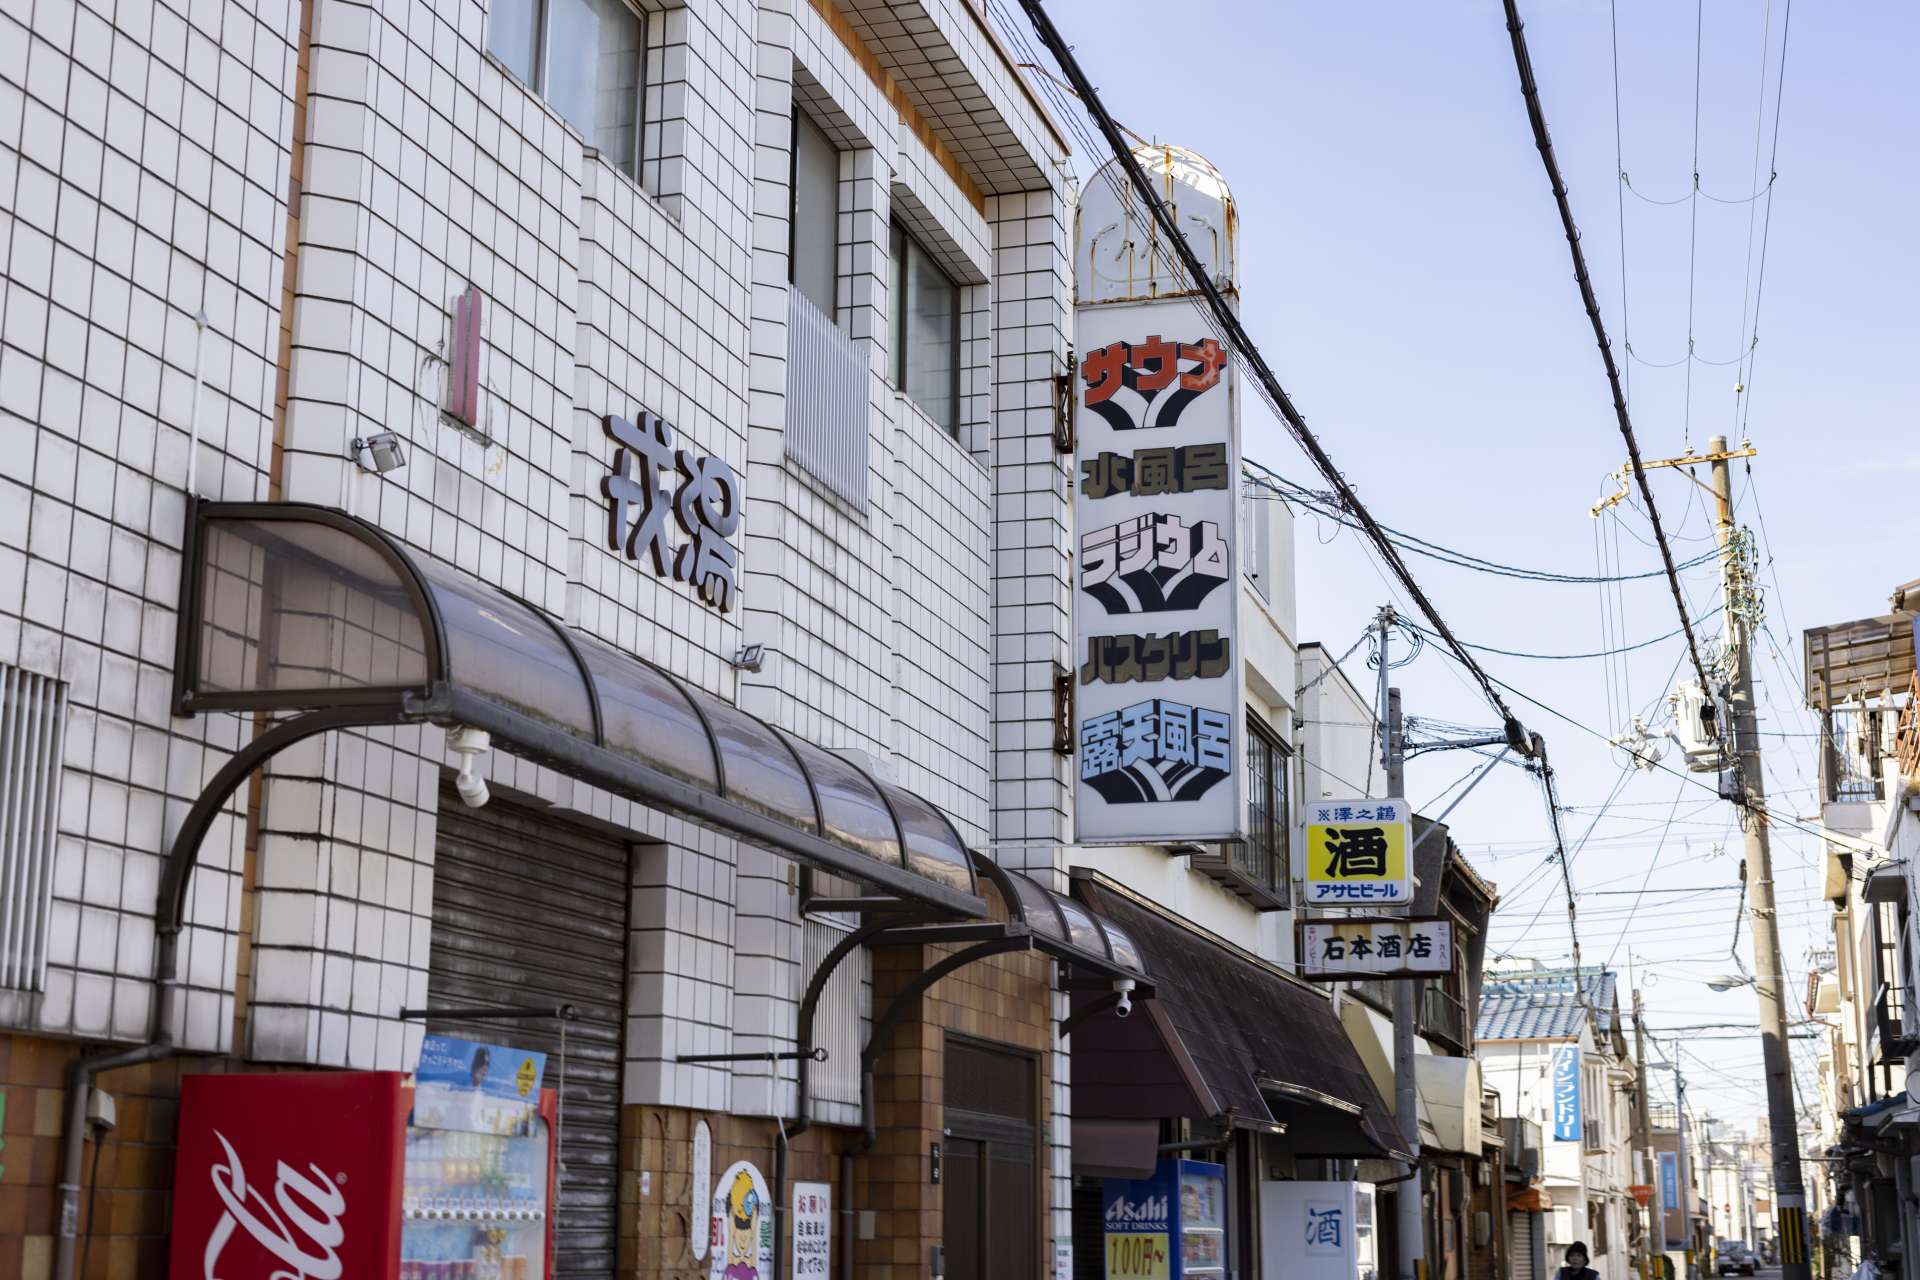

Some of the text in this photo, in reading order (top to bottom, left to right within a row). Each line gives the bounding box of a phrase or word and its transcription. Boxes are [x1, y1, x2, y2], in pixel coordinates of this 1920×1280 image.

[1081, 335, 1228, 409] サウナ
[1081, 442, 1229, 499] 水風呂
[1081, 512, 1229, 589] ラジウム
[1081, 629, 1230, 685] バスクリン
[1081, 699, 1231, 781] 露天風呂
[1324, 827, 1388, 878] 酒
[1316, 884, 1398, 898] アサヒビール
[1322, 933, 1432, 961] 石本酒店
[1105, 1195, 1168, 1221] Asahi
[1105, 1222, 1130, 1231] SOFT
[1305, 1207, 1342, 1248] 酒
